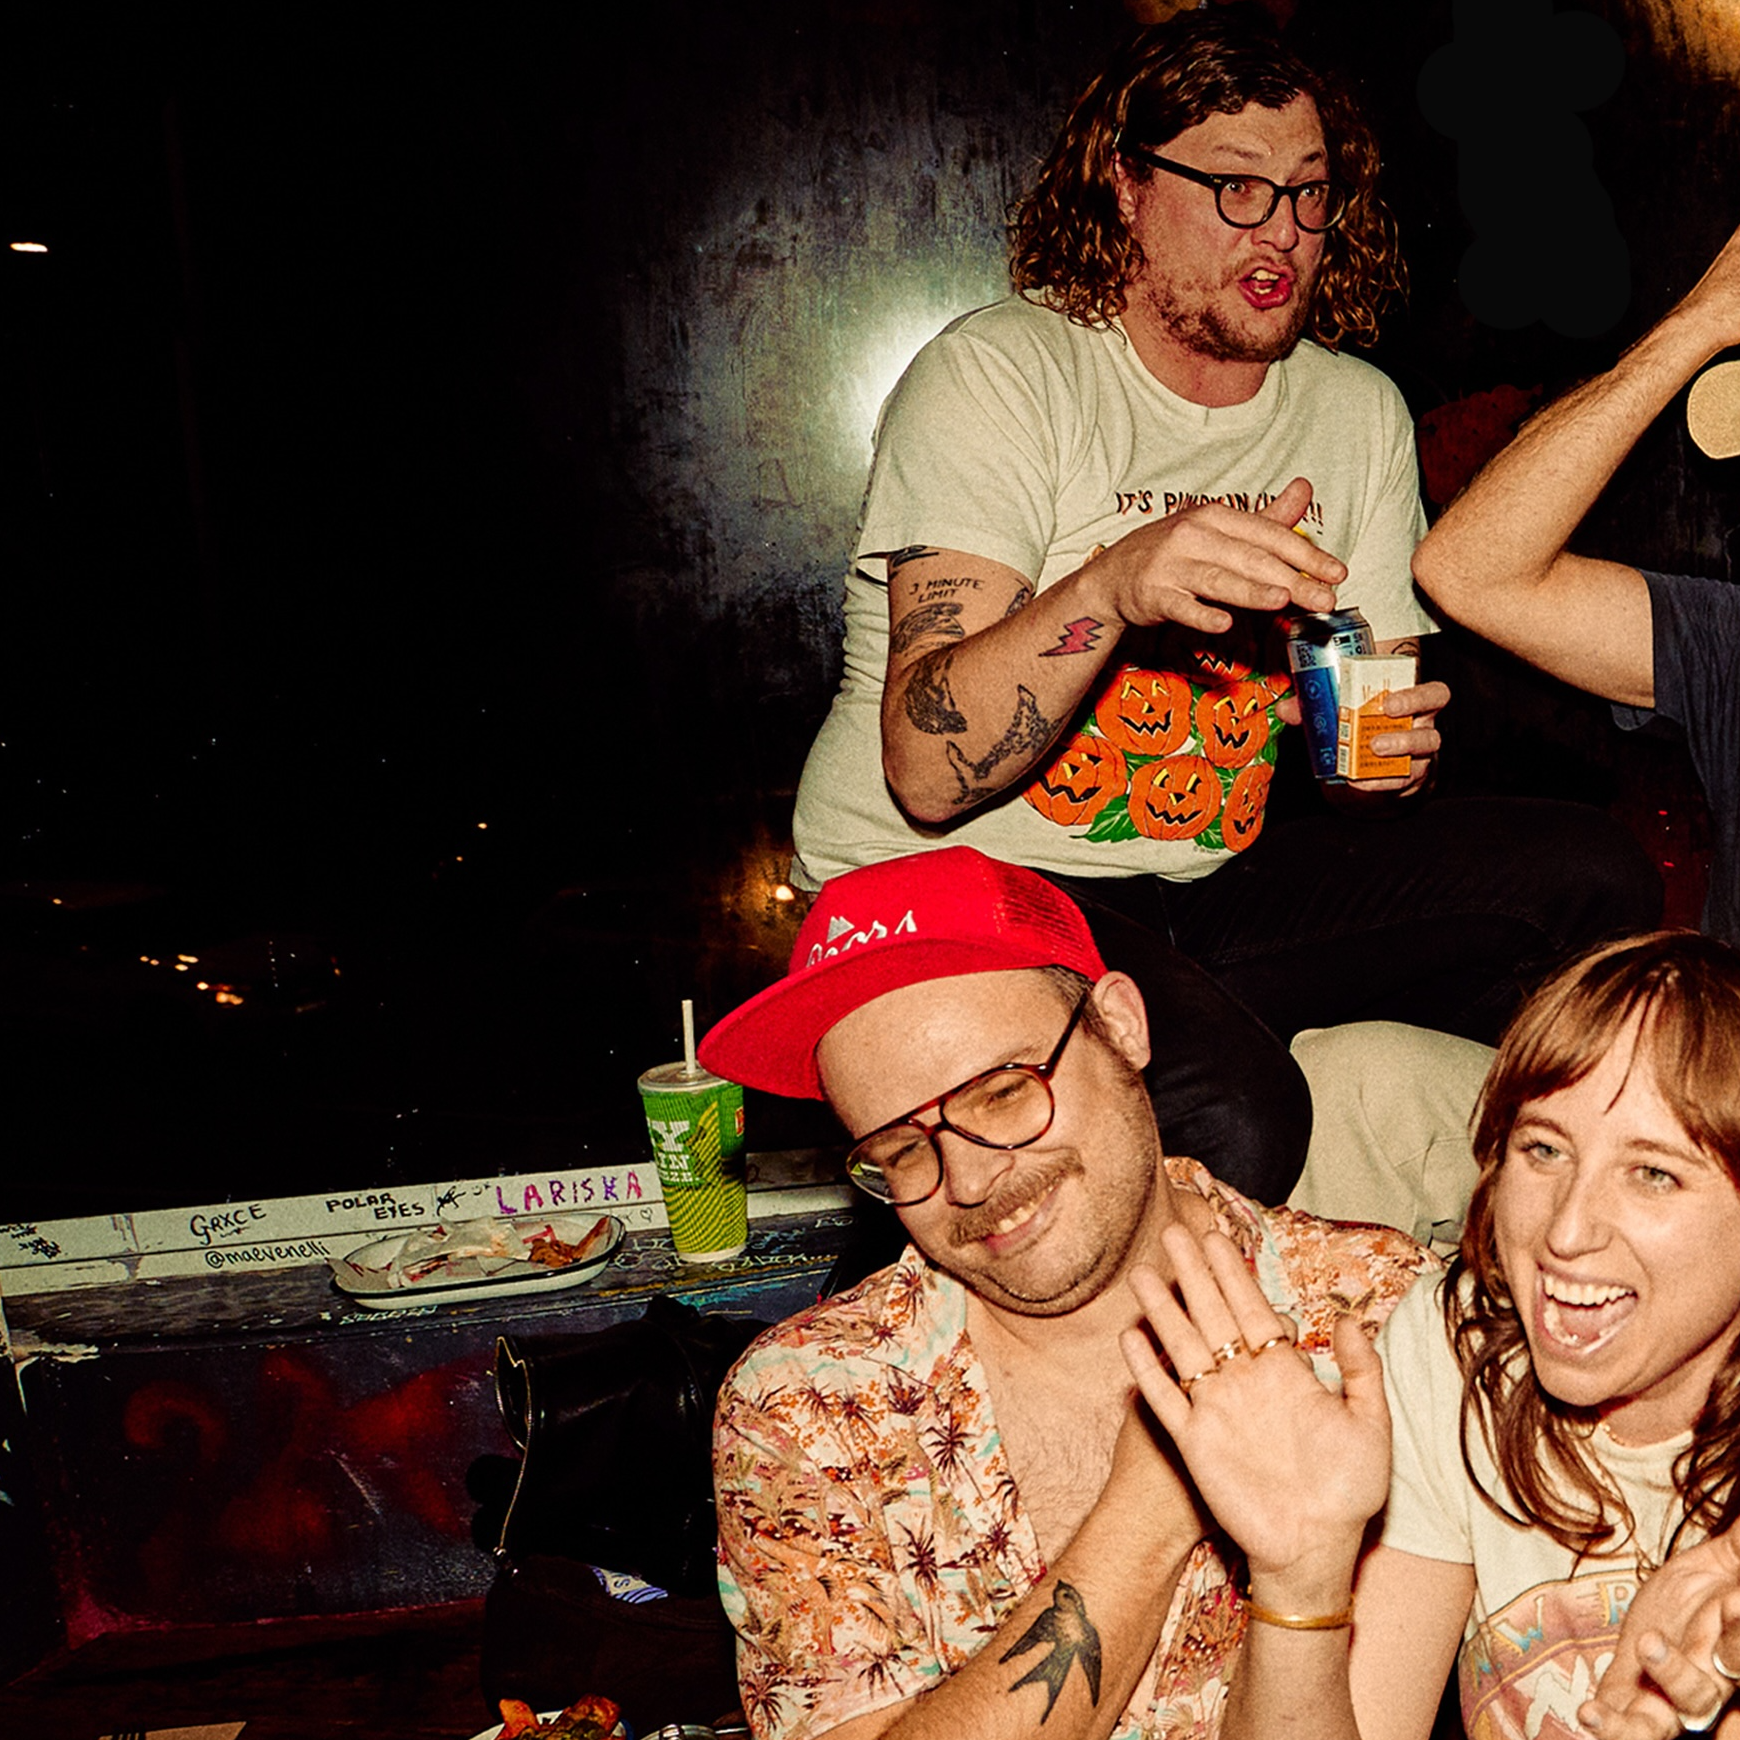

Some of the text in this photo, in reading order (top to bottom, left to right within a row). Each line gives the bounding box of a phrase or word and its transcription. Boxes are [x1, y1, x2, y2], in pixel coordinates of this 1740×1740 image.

[1115, 490, 1153, 515] IT'S
[926, 578, 985, 590] MINUTE
[918, 588, 958, 603] LIMIT
[325, 1192, 397, 1213] POLAR
[495, 1170, 643, 1215] LARISKA
[373, 1202, 425, 1220] EYES
[205, 1241, 331, 1269] @maevenelli
